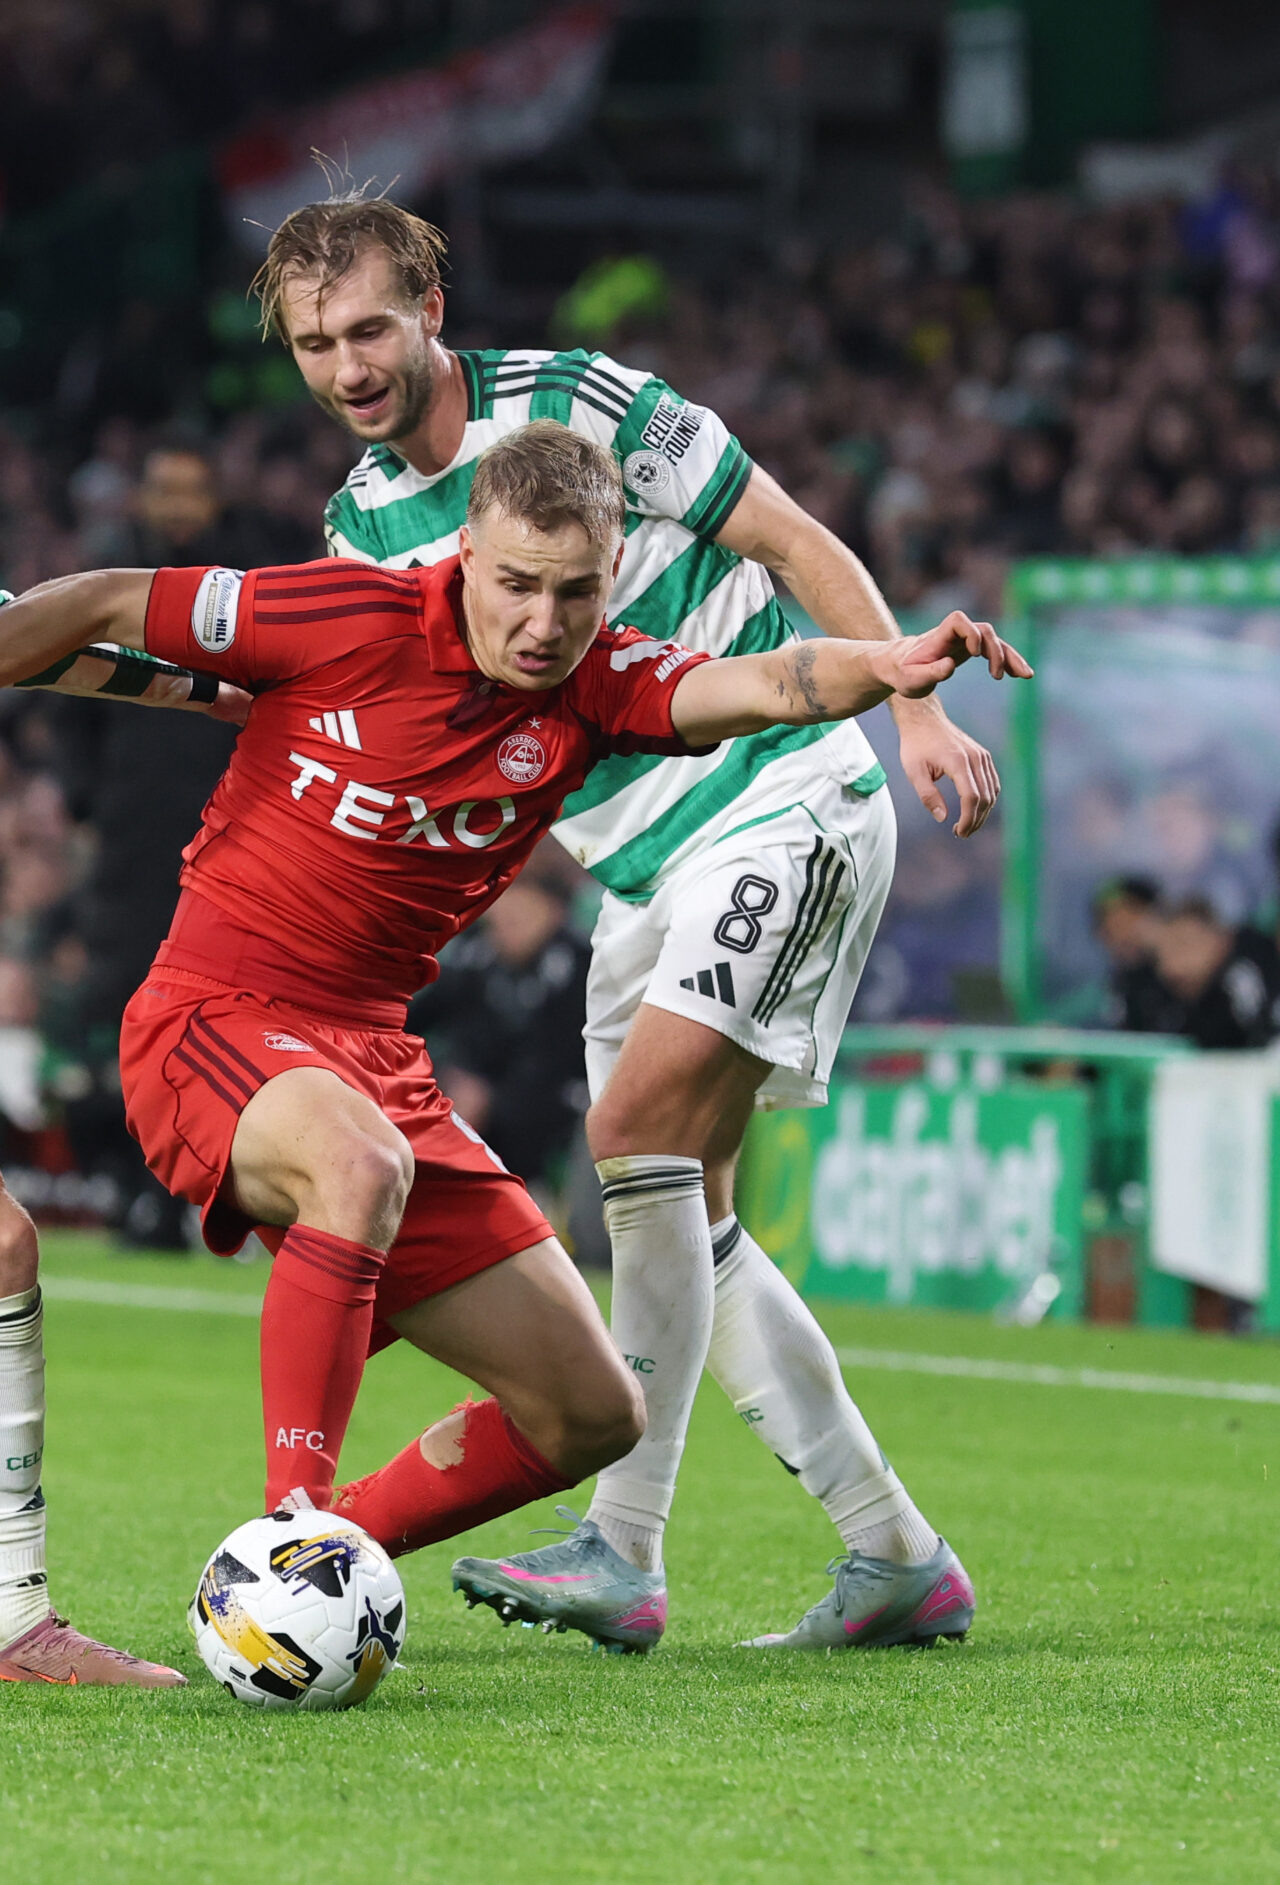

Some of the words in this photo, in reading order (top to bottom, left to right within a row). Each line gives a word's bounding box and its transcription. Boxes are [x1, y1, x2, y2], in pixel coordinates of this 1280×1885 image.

[642, 403, 678, 450] CELTIC
[215, 618, 227, 643] HILL
[507, 736, 540, 752] ABERDEEN
[500, 758, 528, 780] FOOTBALL
[288, 750, 516, 848] TEXO
[713, 873, 779, 954] 8
[275, 1427, 325, 1451] AFC
